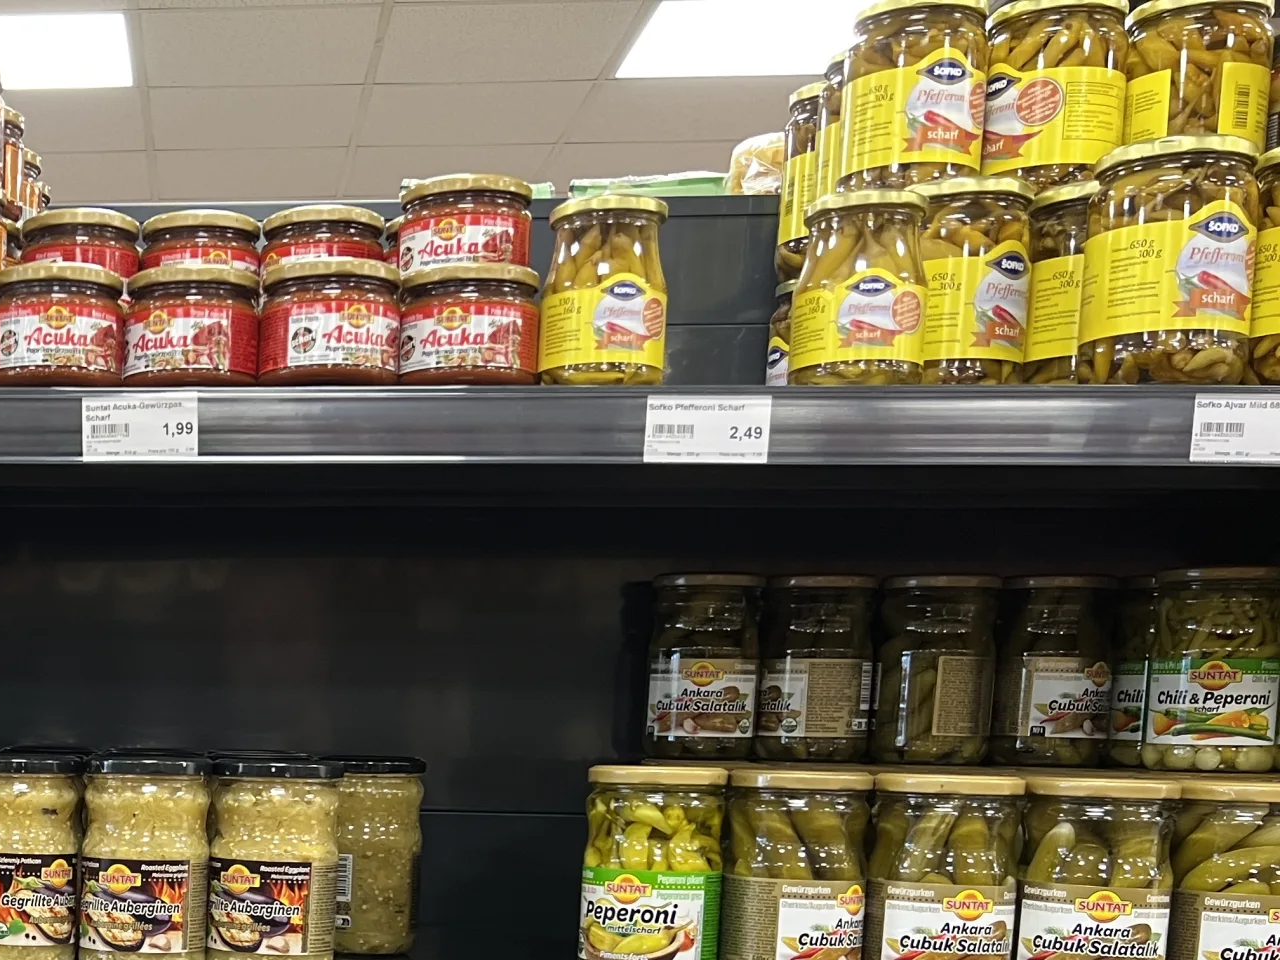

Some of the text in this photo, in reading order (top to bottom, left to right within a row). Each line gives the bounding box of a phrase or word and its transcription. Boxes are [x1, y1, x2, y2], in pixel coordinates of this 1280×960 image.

[927, 128, 960, 142] scharf
[418, 239, 480, 258] Acuka
[1201, 292, 1235, 305] scharf
[25, 327, 90, 347] Acuka
[133, 332, 189, 352] Acuka
[322, 323, 386, 347] Acuka
[420, 328, 486, 348] Acuka
[610, 333, 634, 343] scharf
[854, 330, 881, 341] scharf
[1196, 401, 1268, 411] Sofko Ajvar Mild
[85, 414, 111, 422] Scharf
[163, 422, 193, 437] 1,99
[730, 426, 762, 441] 2,49
[681, 687, 723, 699] Ankara
[1158, 690, 1272, 710] Chili & Peperoni
[140, 864, 189, 874] Roasted Eggplant
[221, 873, 260, 886] SUNTAT
[606, 883, 650, 896] SUNTAT
[782, 885, 831, 896] Gewürzgurken
[2, 893, 51, 910] Gegrillte
[110, 897, 180, 916] Auberginen
[1078, 900, 1130, 914] SUNTAT
[1204, 896, 1261, 909] Gewürzgurken
[230, 900, 299, 919] Auberginen
[586, 899, 678, 926] Peperoni
[607, 925, 661, 936] mittelscharf
[941, 922, 992, 937] Ankara
[1072, 923, 1133, 939] Ankara
[799, 932, 846, 951] Çubuk
[900, 934, 955, 954] Çubuk
[1032, 935, 1159, 959] Çubuk Salatalık
